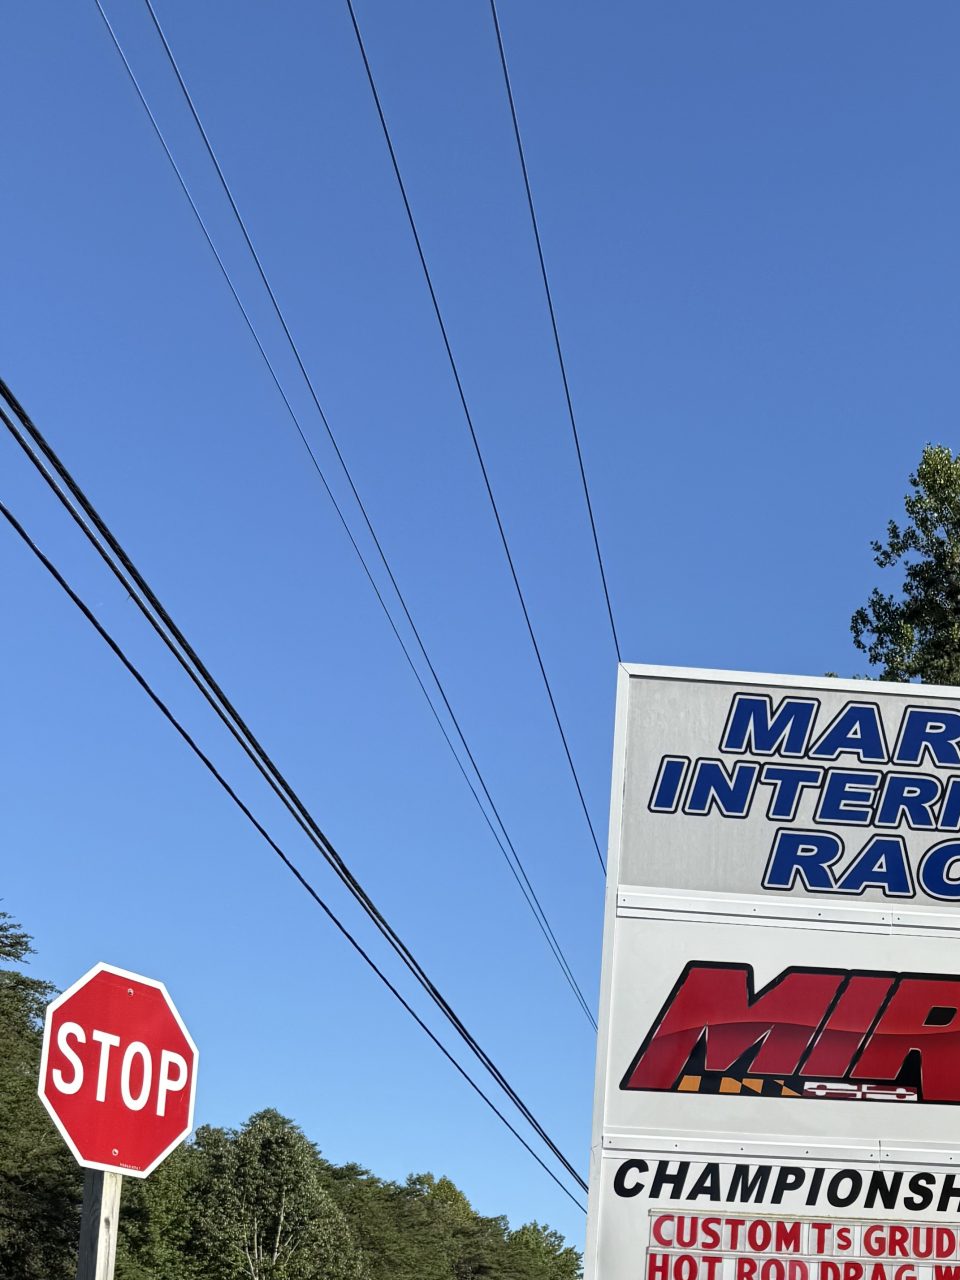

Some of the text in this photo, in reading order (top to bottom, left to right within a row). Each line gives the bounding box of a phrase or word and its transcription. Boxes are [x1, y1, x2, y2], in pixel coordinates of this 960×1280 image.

[52, 1021, 188, 1117] STOP
[652, 1214, 801, 1253] CUSTOM
[810, 1222, 853, 1252] Ts
